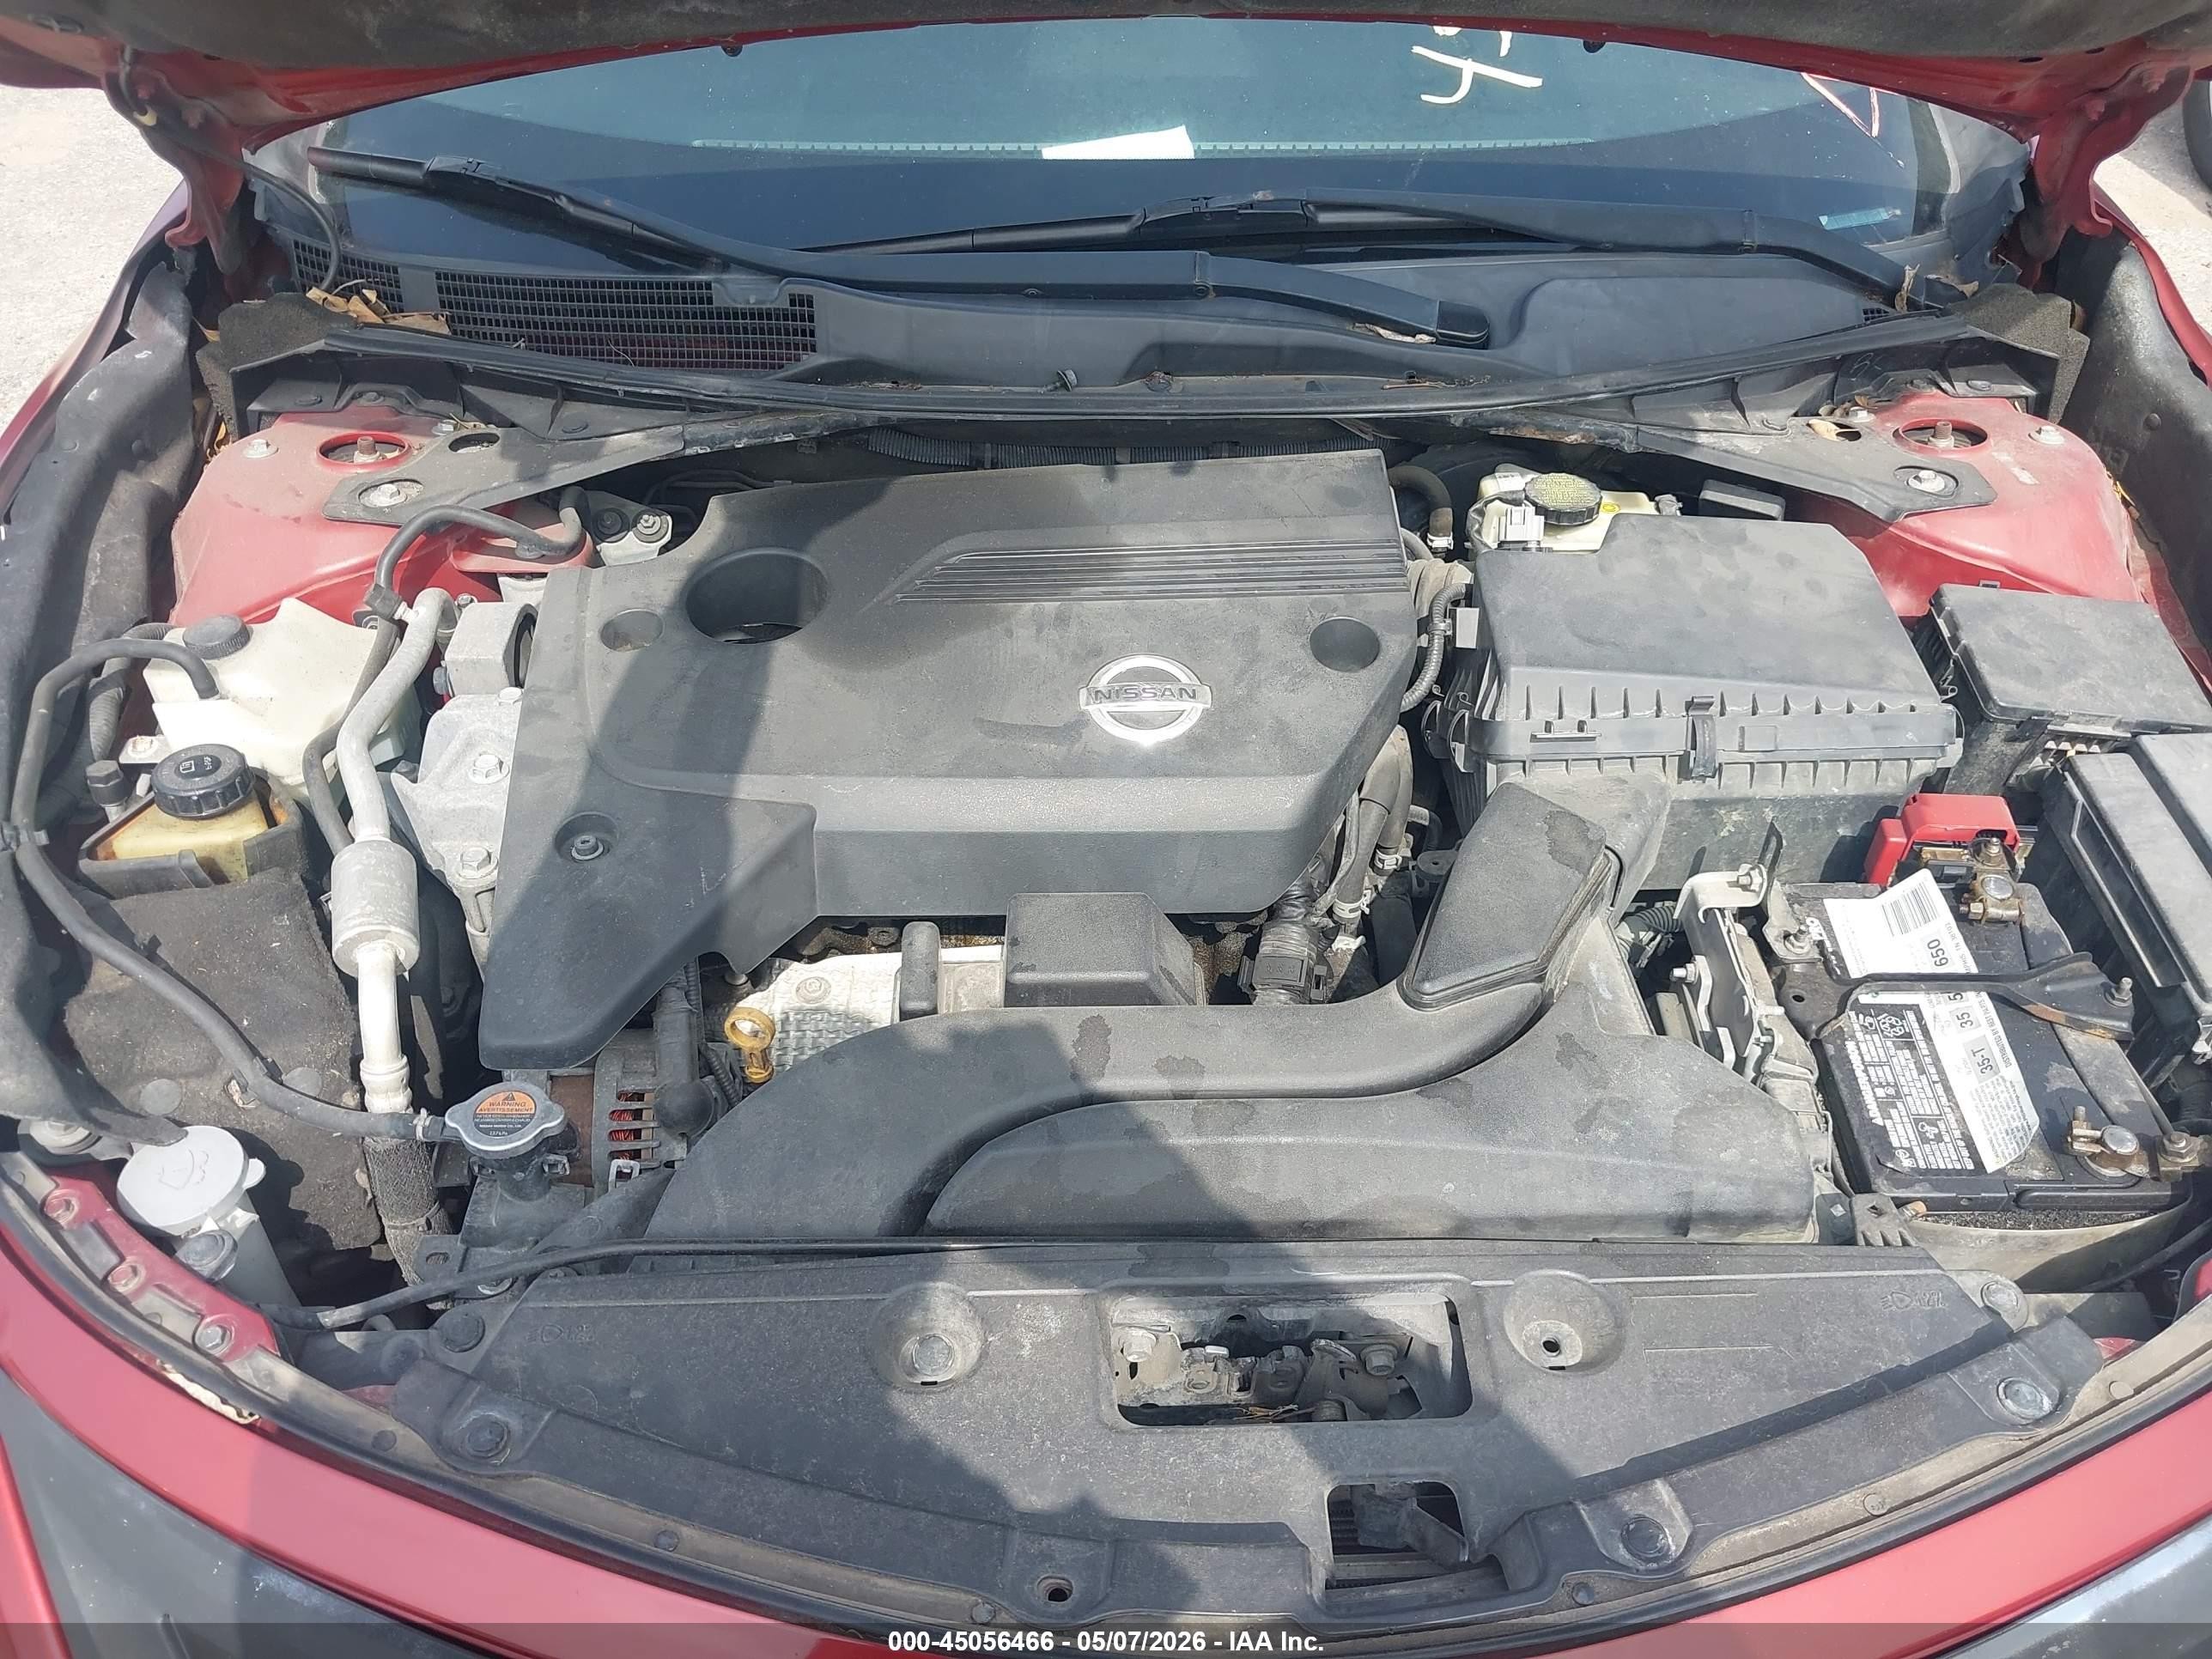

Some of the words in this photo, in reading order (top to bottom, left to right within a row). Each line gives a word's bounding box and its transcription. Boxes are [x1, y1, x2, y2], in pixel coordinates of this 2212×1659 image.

[1094, 687, 1197, 701] NISSAN
[1925, 937, 1949, 968] 650
[1955, 1009, 1974, 1030] 35
[1971, 1044, 1994, 1075] 35-T
